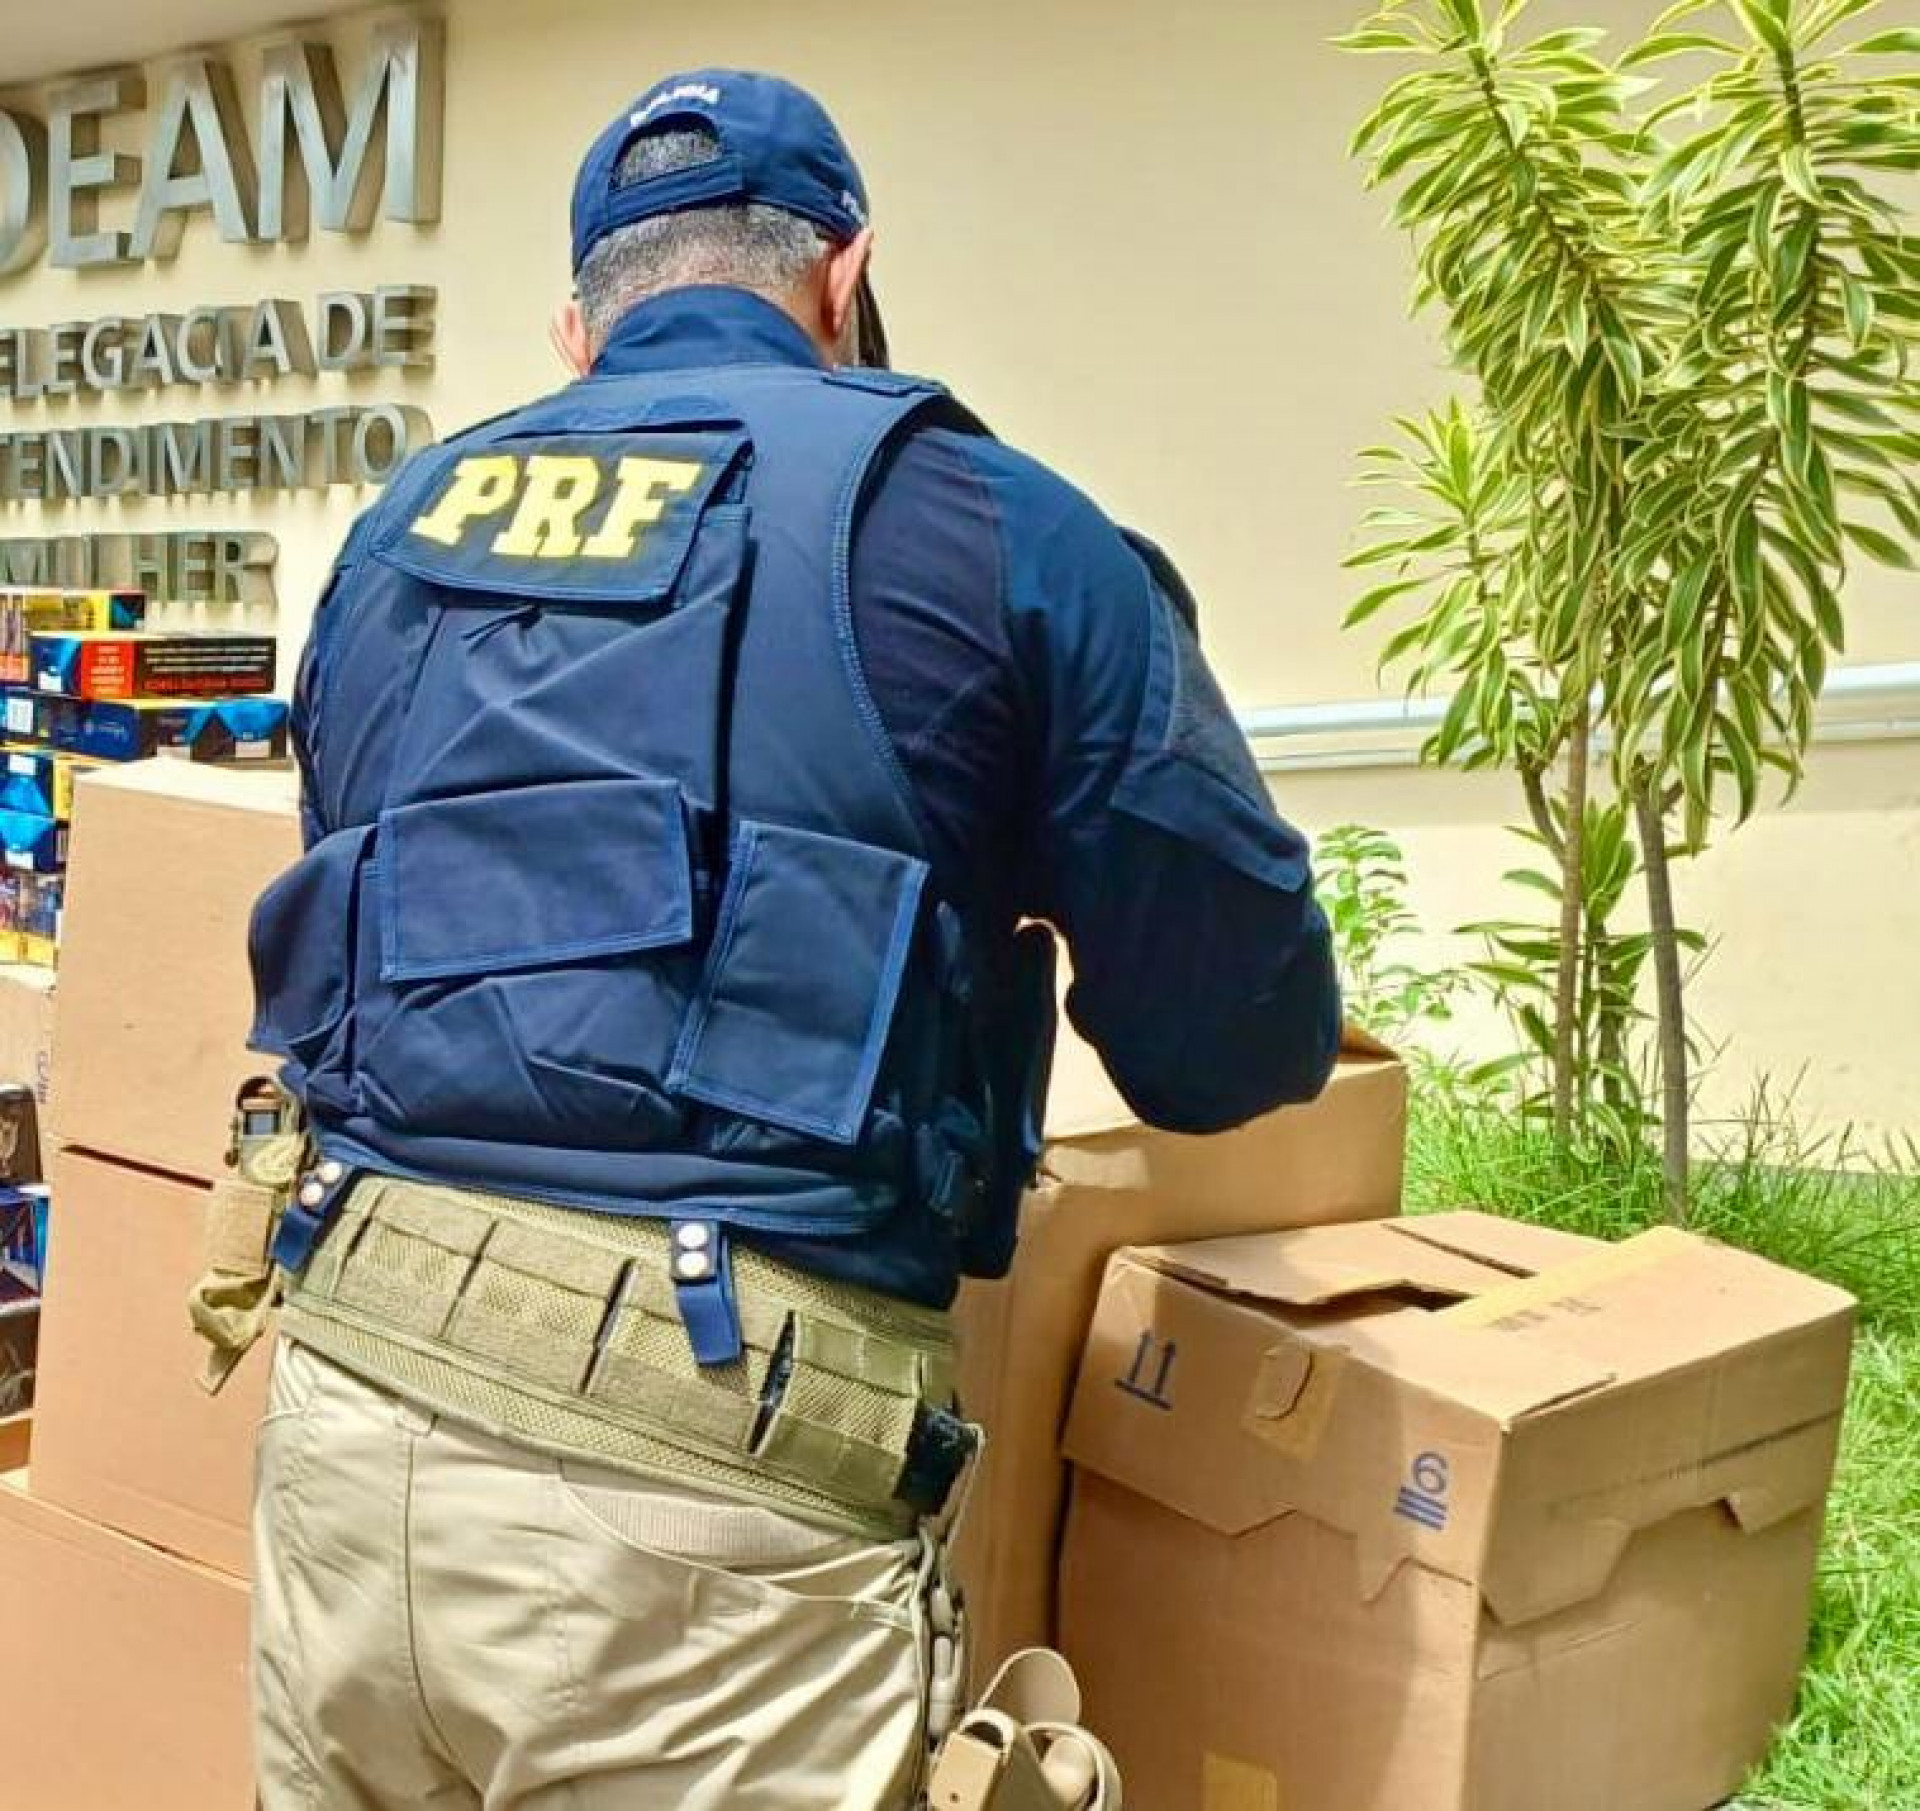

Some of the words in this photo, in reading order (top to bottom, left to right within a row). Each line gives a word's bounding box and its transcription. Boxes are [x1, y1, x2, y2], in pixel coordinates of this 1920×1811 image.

[319, 285, 428, 372] DE
[0, 403, 418, 499] ENDIMENTO
[408, 455, 701, 558] PRF
